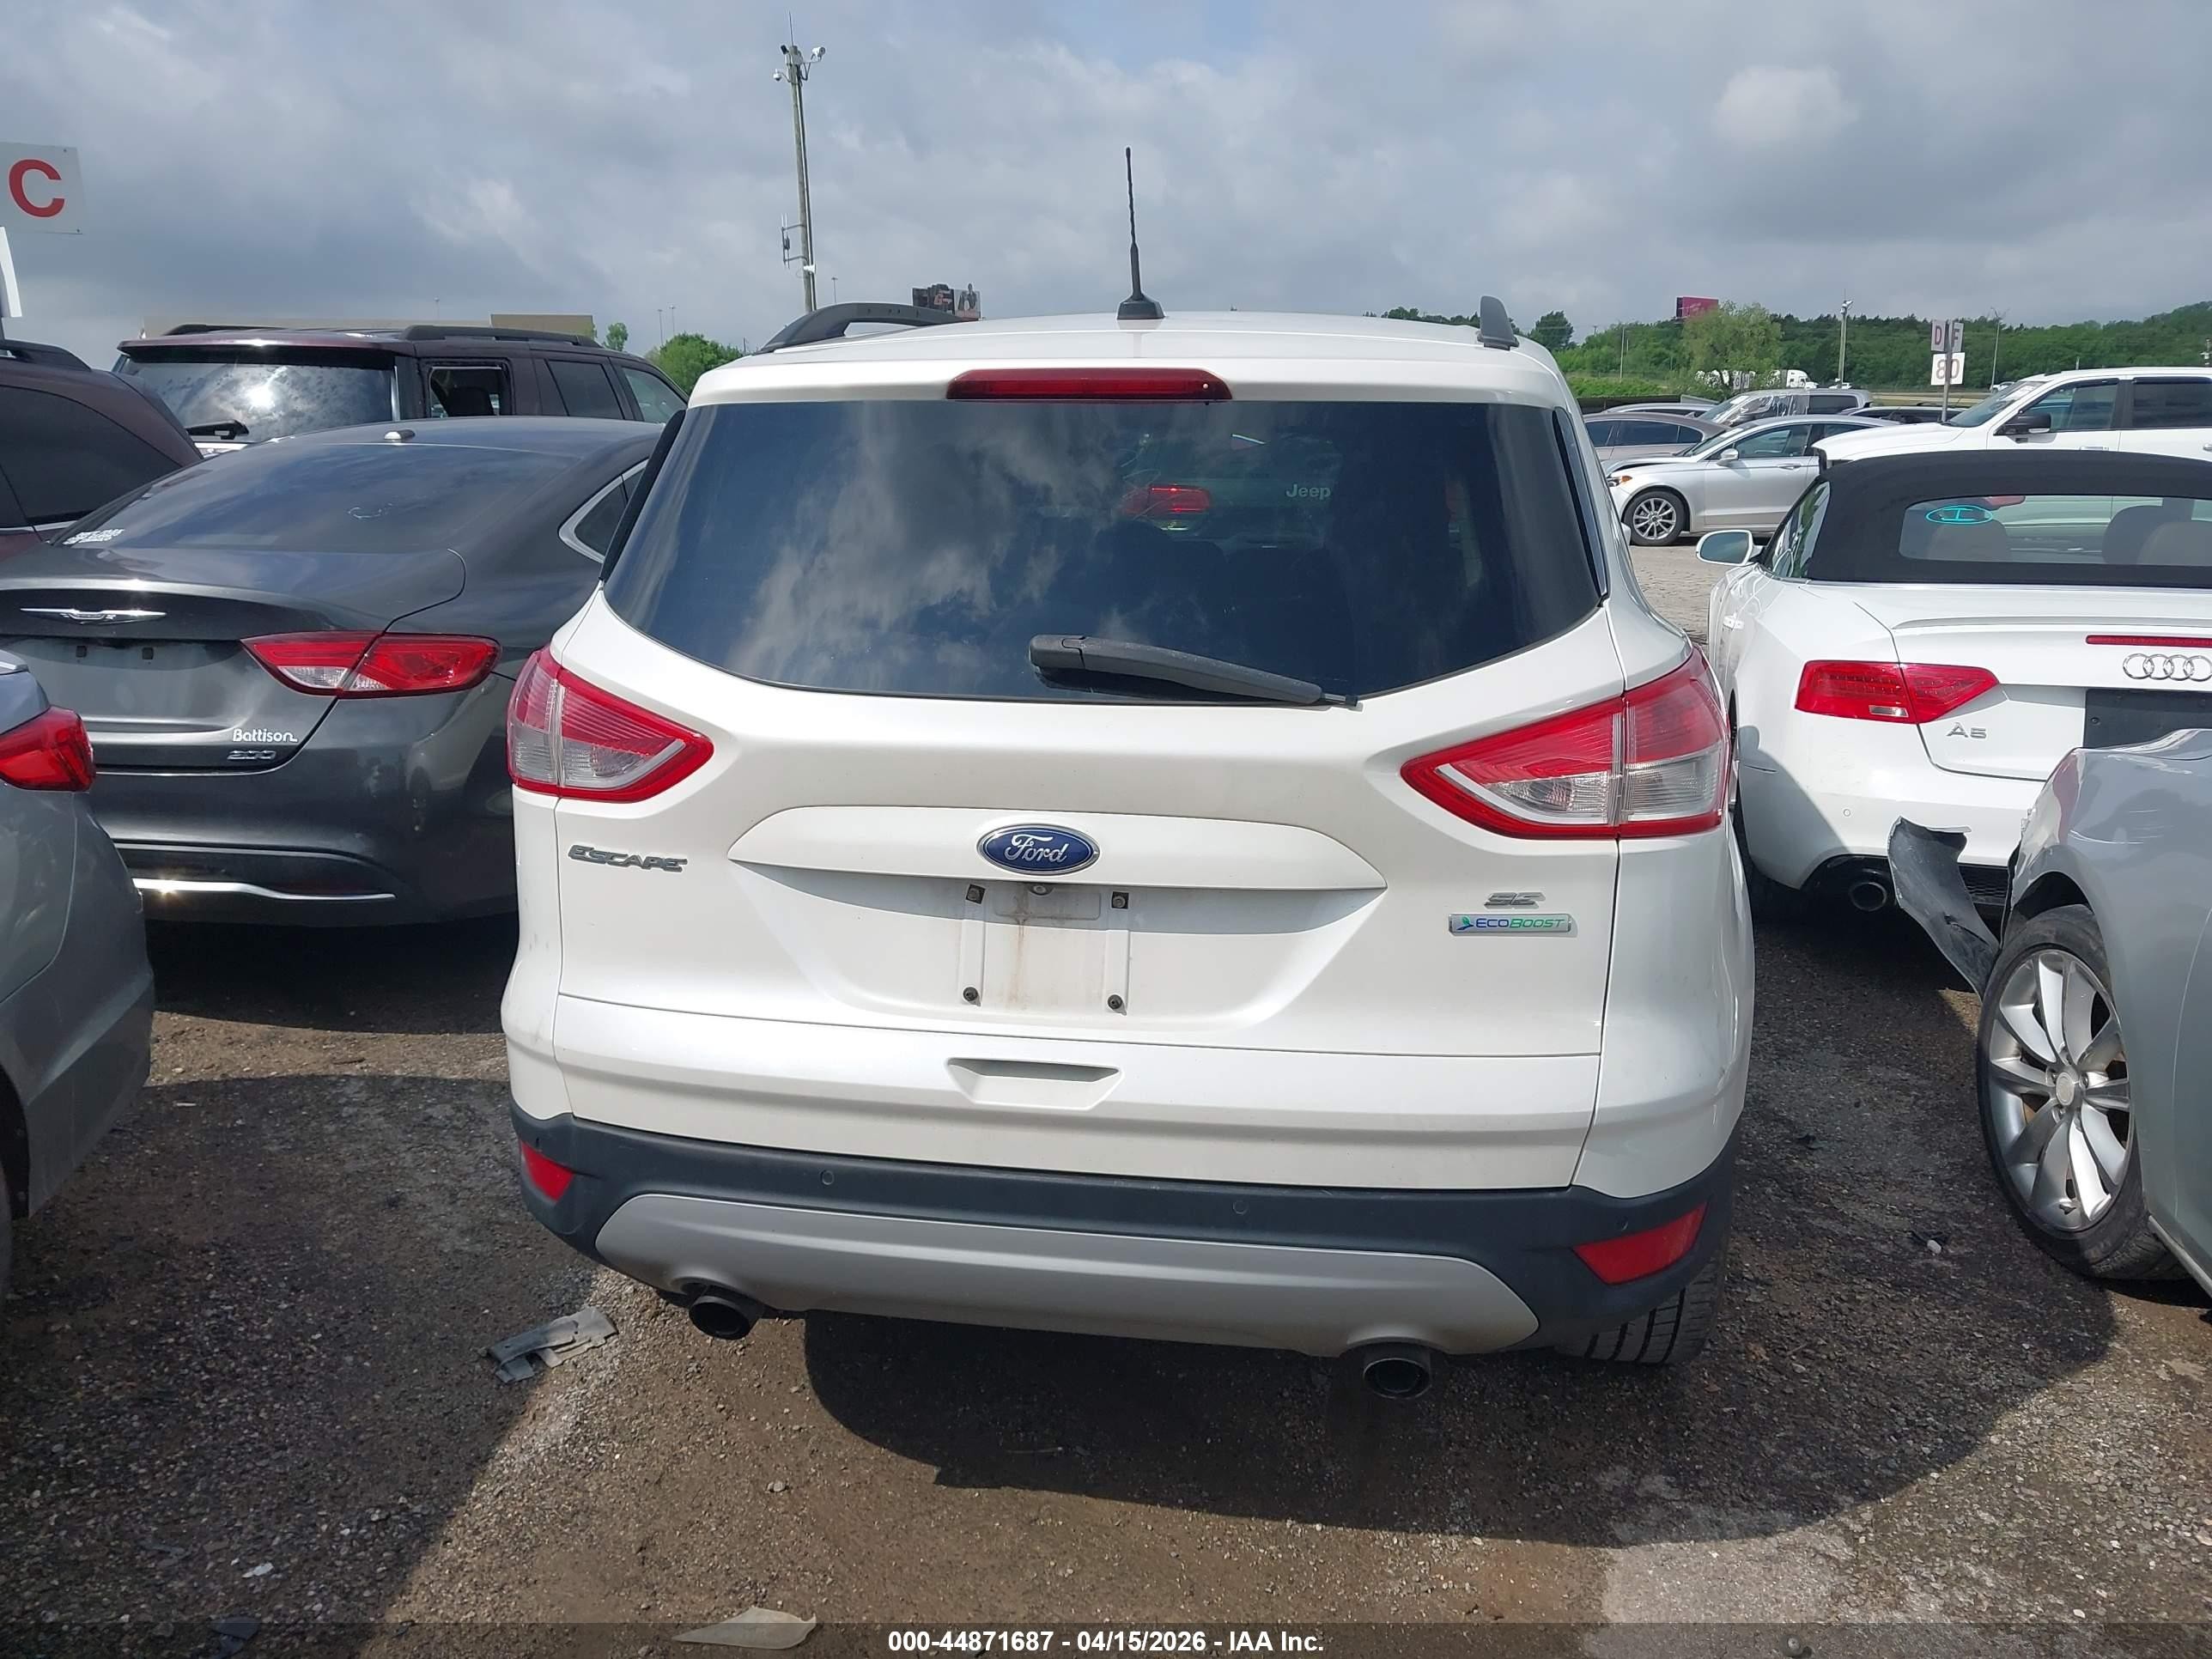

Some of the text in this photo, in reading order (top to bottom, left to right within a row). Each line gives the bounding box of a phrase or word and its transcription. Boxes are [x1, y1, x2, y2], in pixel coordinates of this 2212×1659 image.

[9, 159, 65, 218] C
[1935, 325, 1942, 345] D
[1936, 358, 1960, 380] 80
[1285, 483, 1331, 500] Jeep
[233, 728, 298, 743] Battison
[1946, 721, 1987, 739] A5
[227, 750, 276, 761] 200
[1004, 833, 1070, 863] Ford
[568, 844, 688, 873] ESCAPE
[1484, 891, 1546, 909] SE
[1475, 918, 1565, 928] ECOBOOST
